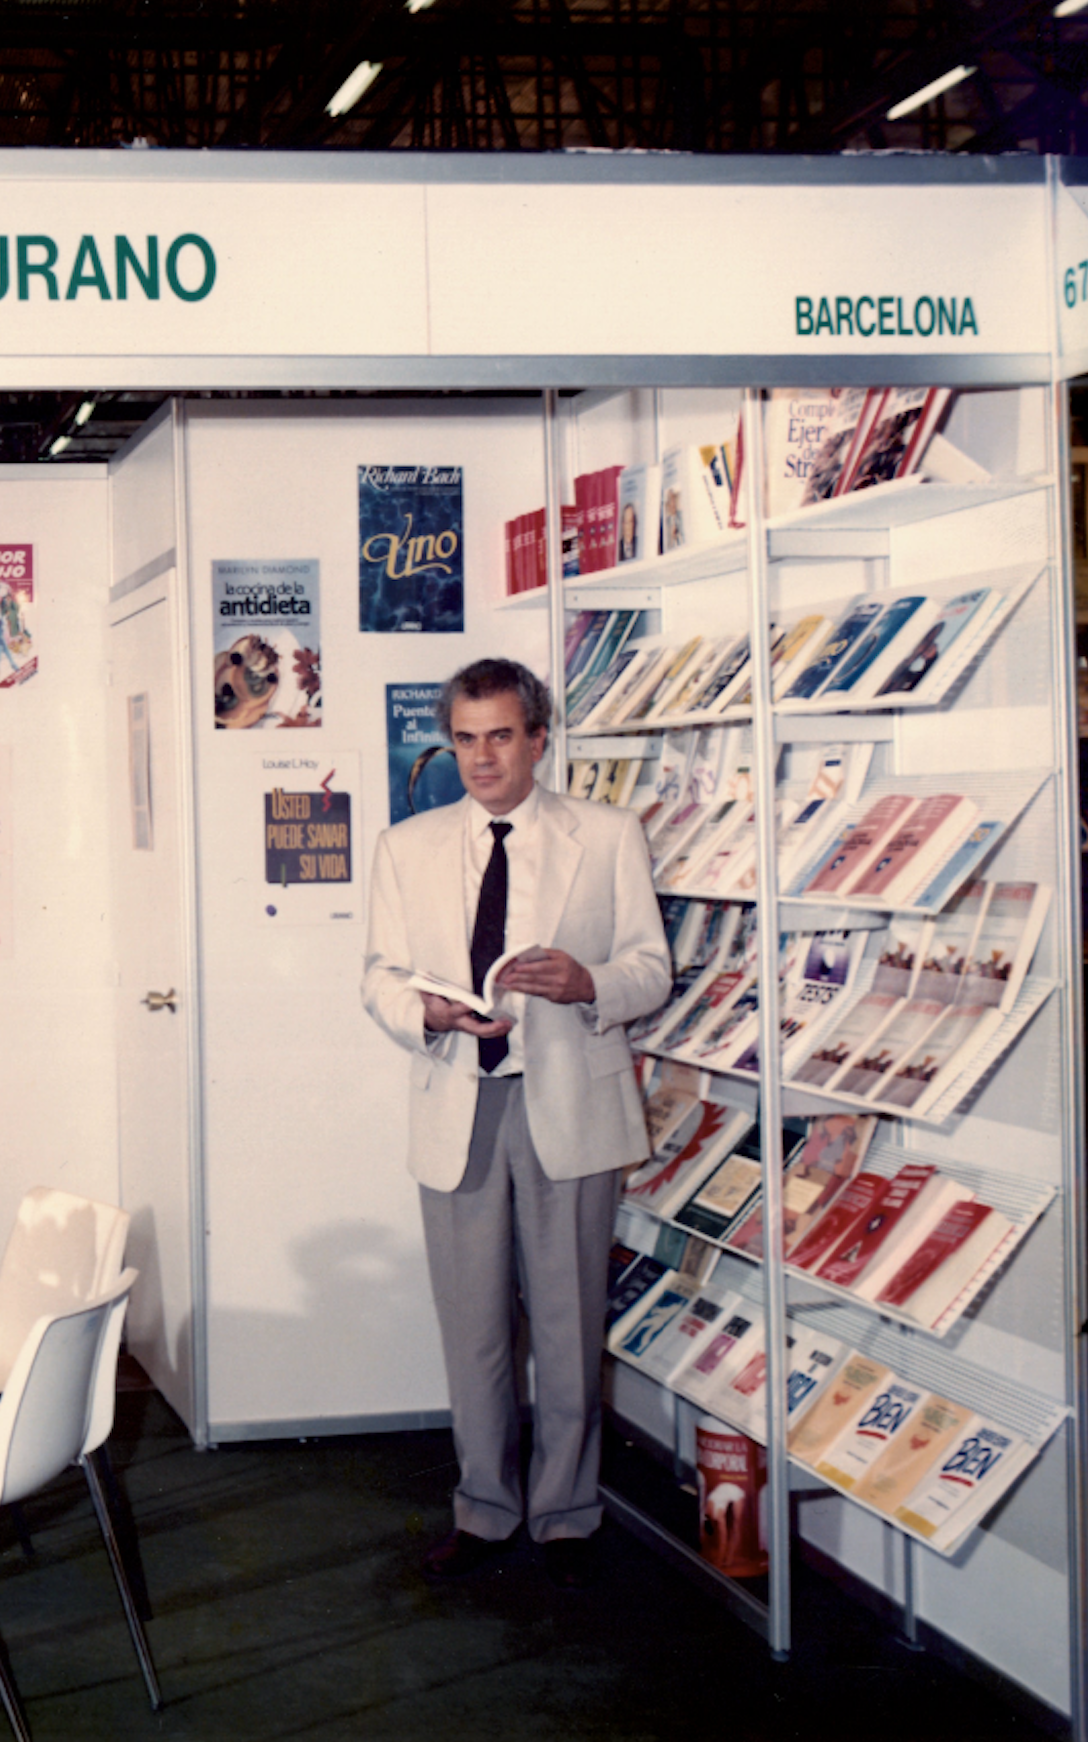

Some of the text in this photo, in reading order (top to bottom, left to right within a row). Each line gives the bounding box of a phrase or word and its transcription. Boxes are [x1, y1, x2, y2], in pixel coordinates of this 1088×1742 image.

[795, 295, 979, 337] BARCELONA
[360, 464, 420, 492] Richard
[422, 464, 461, 485] Bach
[362, 512, 458, 580] Uno
[218, 564, 311, 575] MARILYN DIAMOND
[225, 580, 305, 595] la cocina de la
[219, 594, 311, 617] antidieta
[392, 688, 443, 700] RICHARD
[406, 718, 417, 731] al
[262, 758, 291, 769] Louise
[266, 822, 348, 850] PUEDE SANAR
[298, 853, 349, 880] SU VIDA
